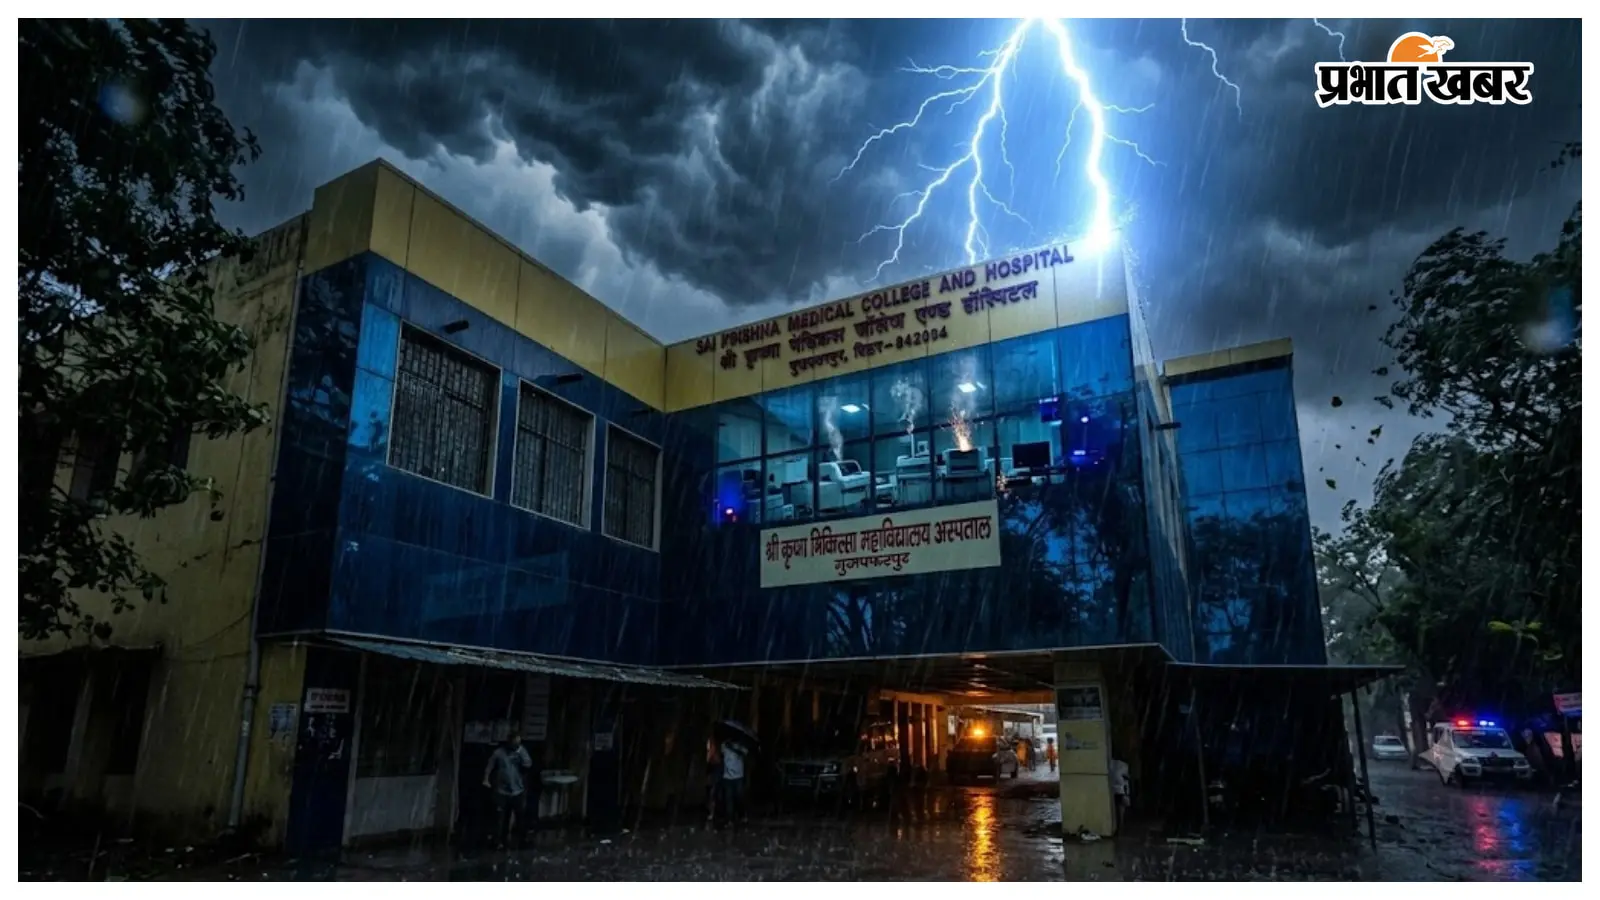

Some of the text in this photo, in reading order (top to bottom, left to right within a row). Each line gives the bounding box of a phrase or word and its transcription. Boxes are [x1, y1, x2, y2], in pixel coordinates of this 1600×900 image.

[788, 305, 854, 331] MEDICAL
[861, 282, 930, 313] COLLEGE
[939, 270, 976, 293] AND
[985, 247, 1074, 277] HOSPITAL
[934, 515, 992, 544] अस्पताल
